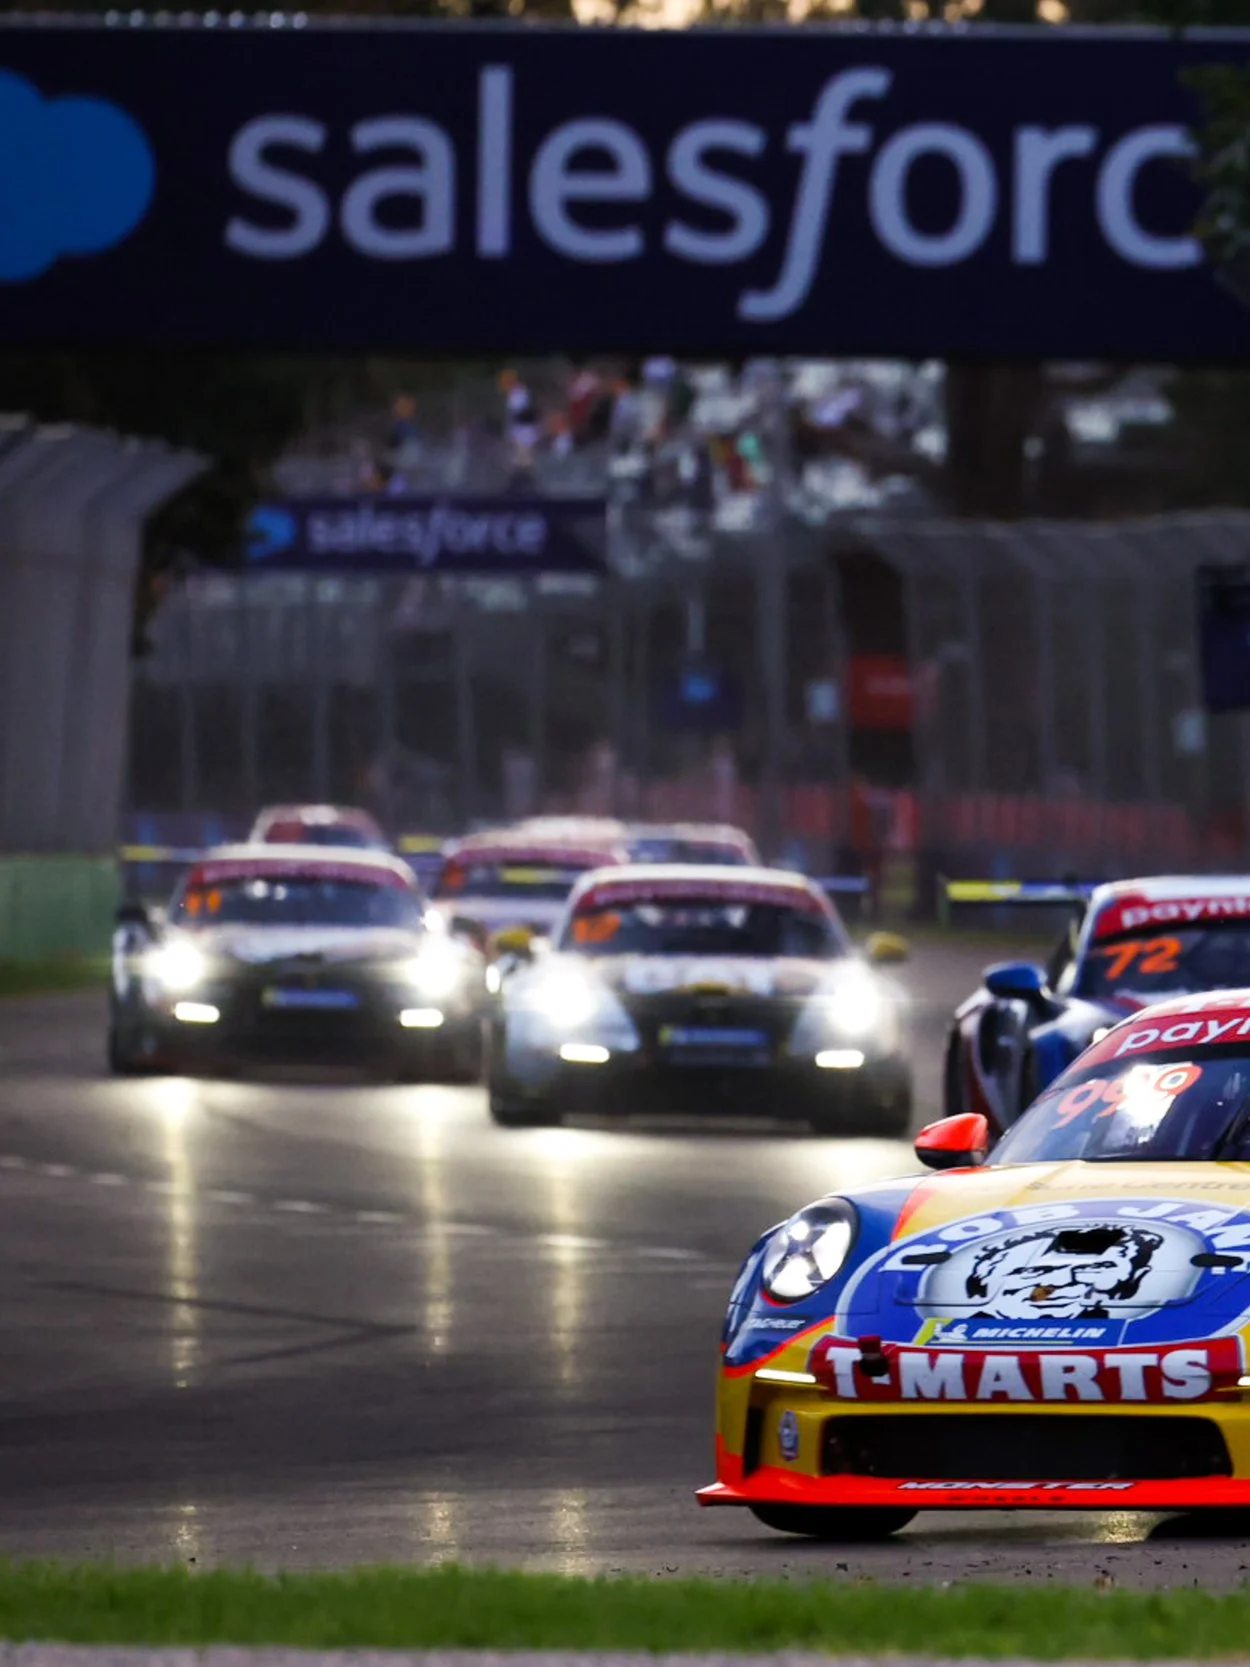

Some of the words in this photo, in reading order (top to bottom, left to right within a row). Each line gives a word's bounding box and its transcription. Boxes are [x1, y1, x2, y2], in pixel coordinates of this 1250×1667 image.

[225, 66, 1204, 322] salesforc
[306, 503, 547, 566] salesforce
[1104, 936, 1183, 982] 72
[971, 1326, 1106, 1341] MICHELIN
[825, 1346, 1211, 1401] T-MARTS
